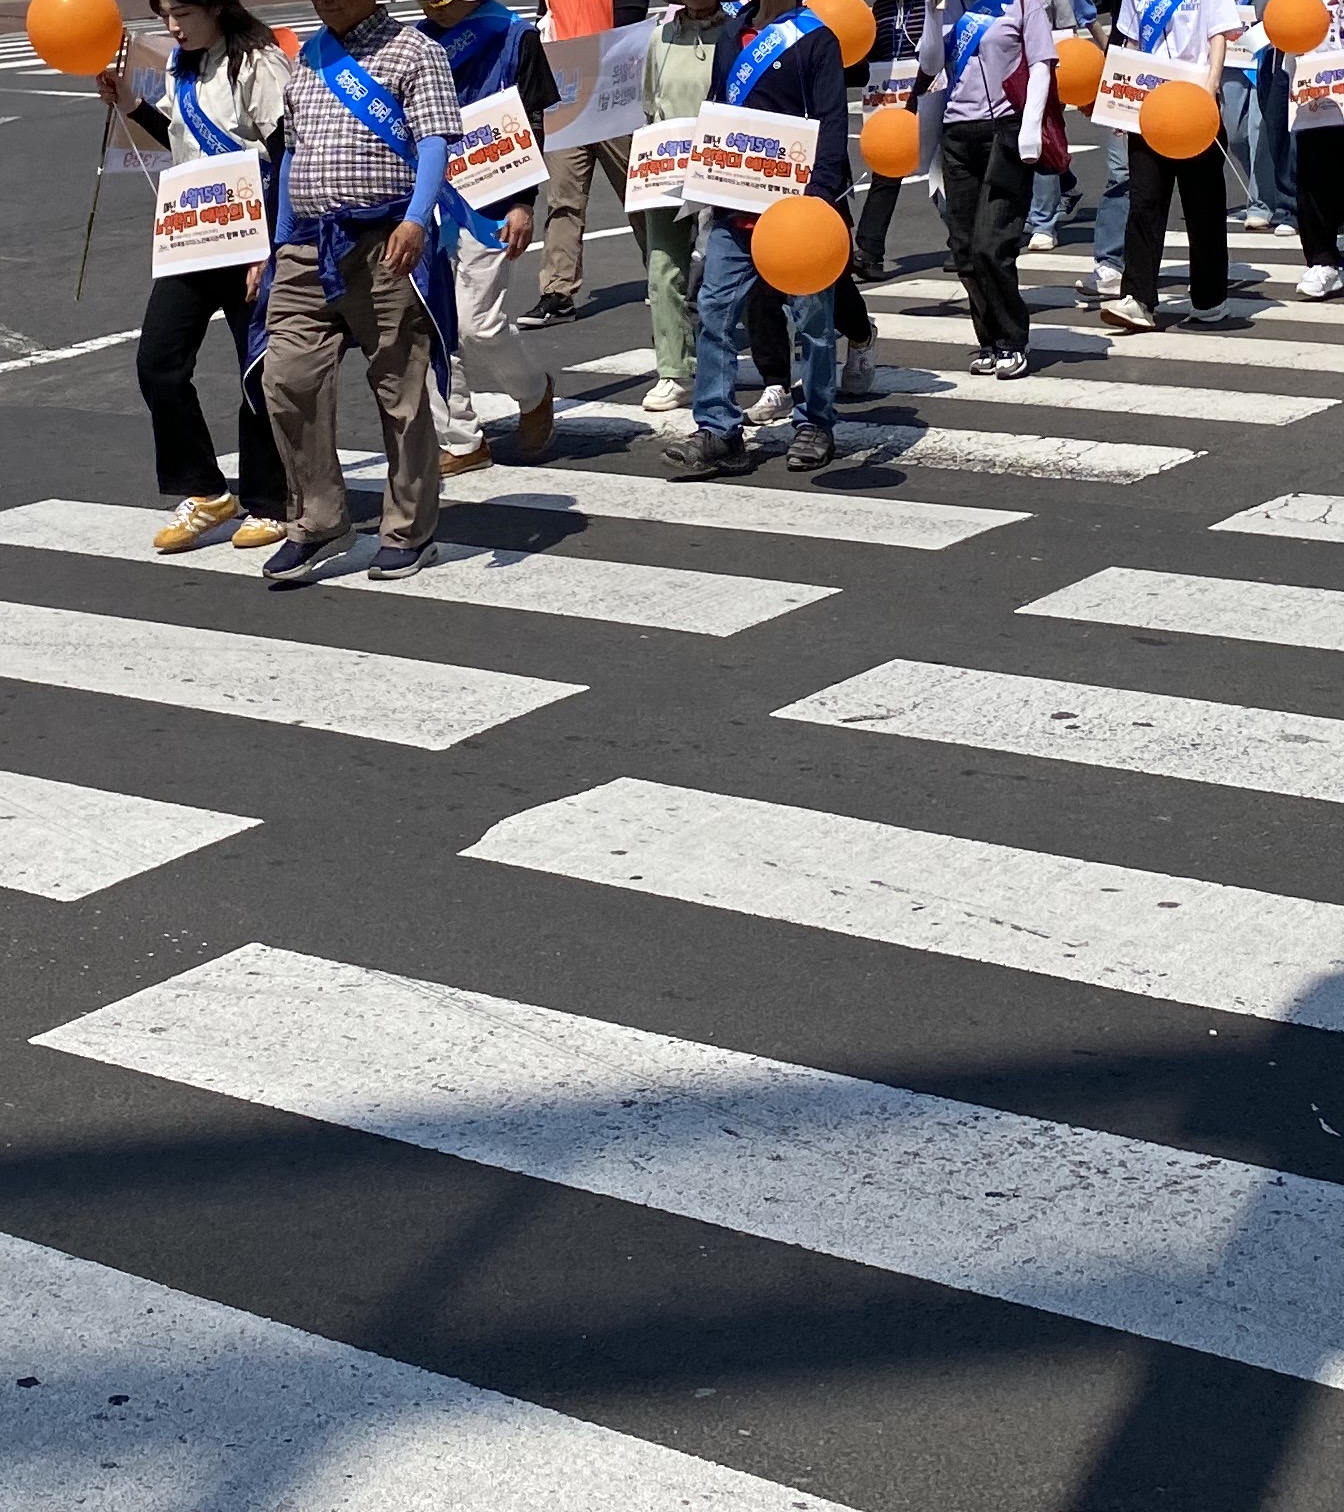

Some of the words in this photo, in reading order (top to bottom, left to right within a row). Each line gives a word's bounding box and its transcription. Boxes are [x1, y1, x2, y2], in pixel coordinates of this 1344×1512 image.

[657, 138, 691, 157] 6월15
[703, 134, 721, 148] 매년
[726, 132, 787, 160] 6월15일은
[629, 157, 675, 181] 노인학대
[691, 145, 743, 169] 노인학대
[745, 155, 792, 178] 예방의
[795, 163, 812, 184] 날
[180, 182, 235, 209] 6월15일은
[155, 209, 198, 236] 노인학대
[199, 201, 244, 226] 예방의
[245, 198, 262, 221] 날
